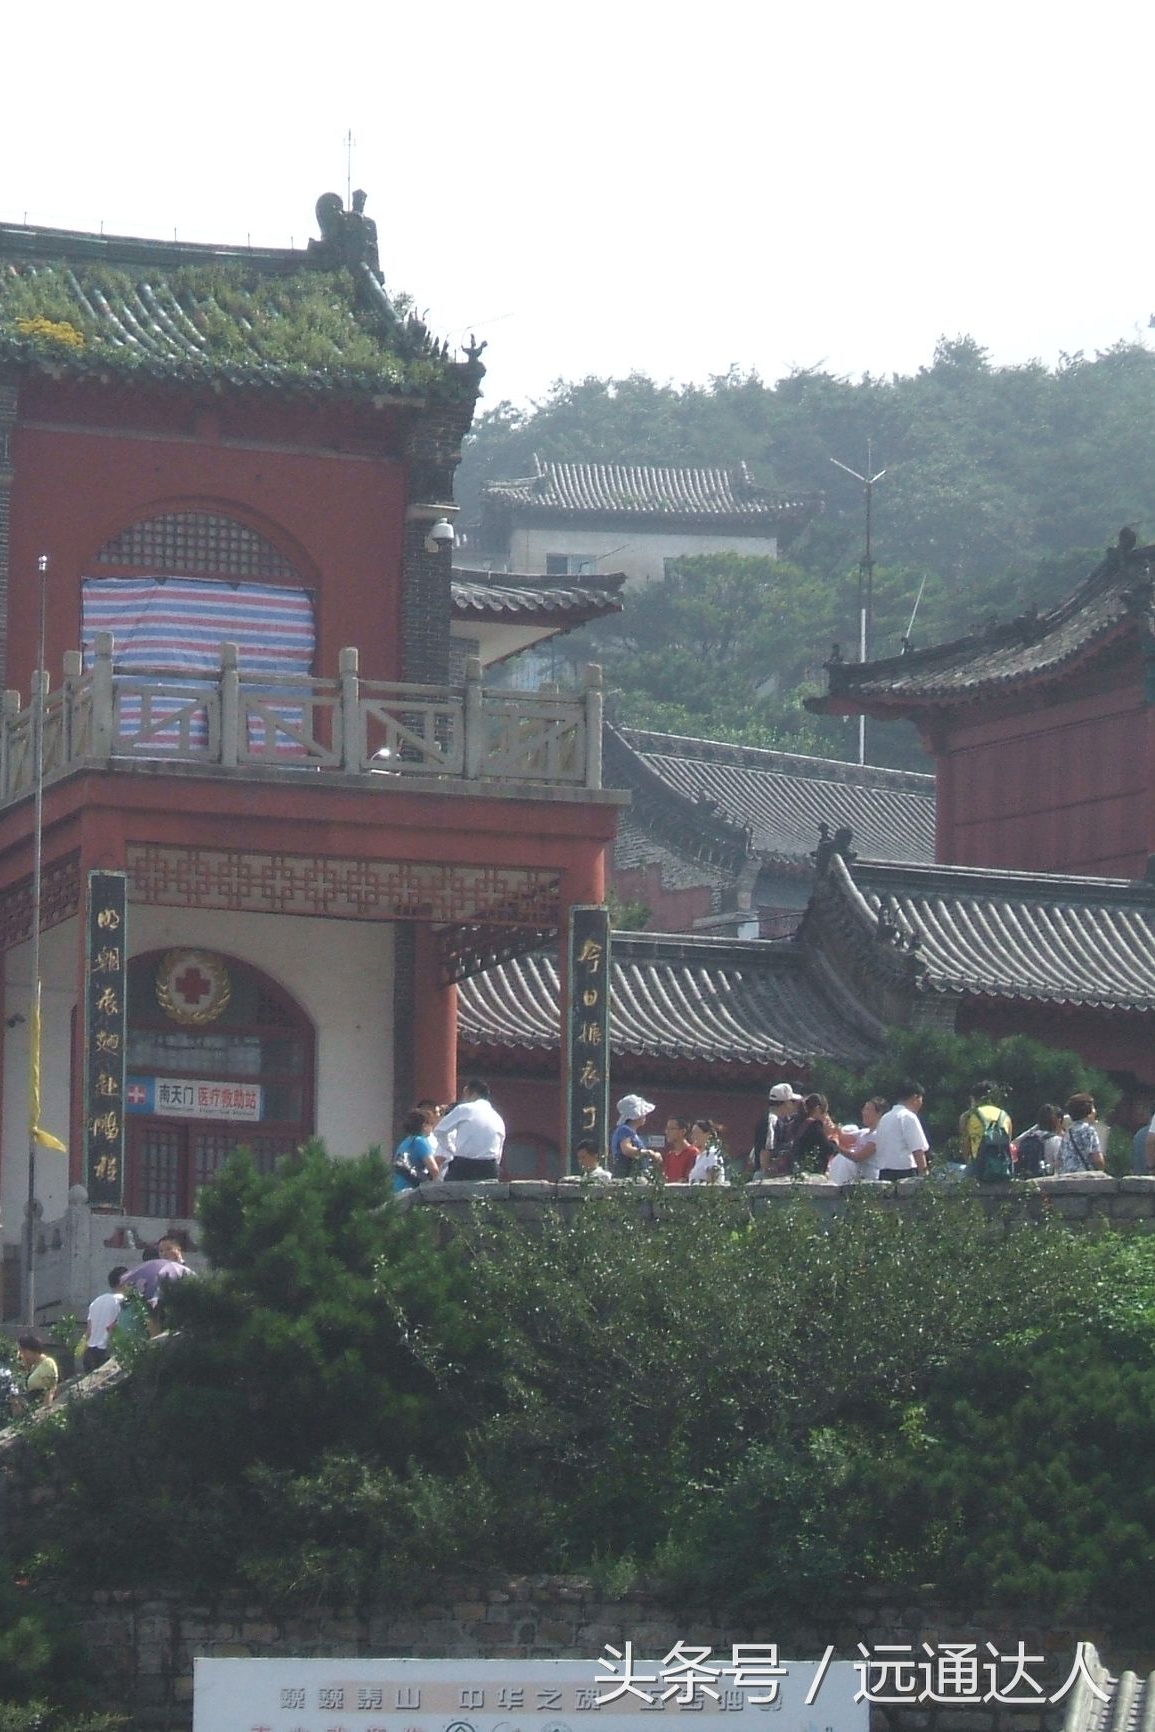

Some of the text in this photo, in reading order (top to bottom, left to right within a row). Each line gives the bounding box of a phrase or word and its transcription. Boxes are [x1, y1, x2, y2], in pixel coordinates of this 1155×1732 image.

[159, 1084, 256, 1110] 南天门 医疗救助站
